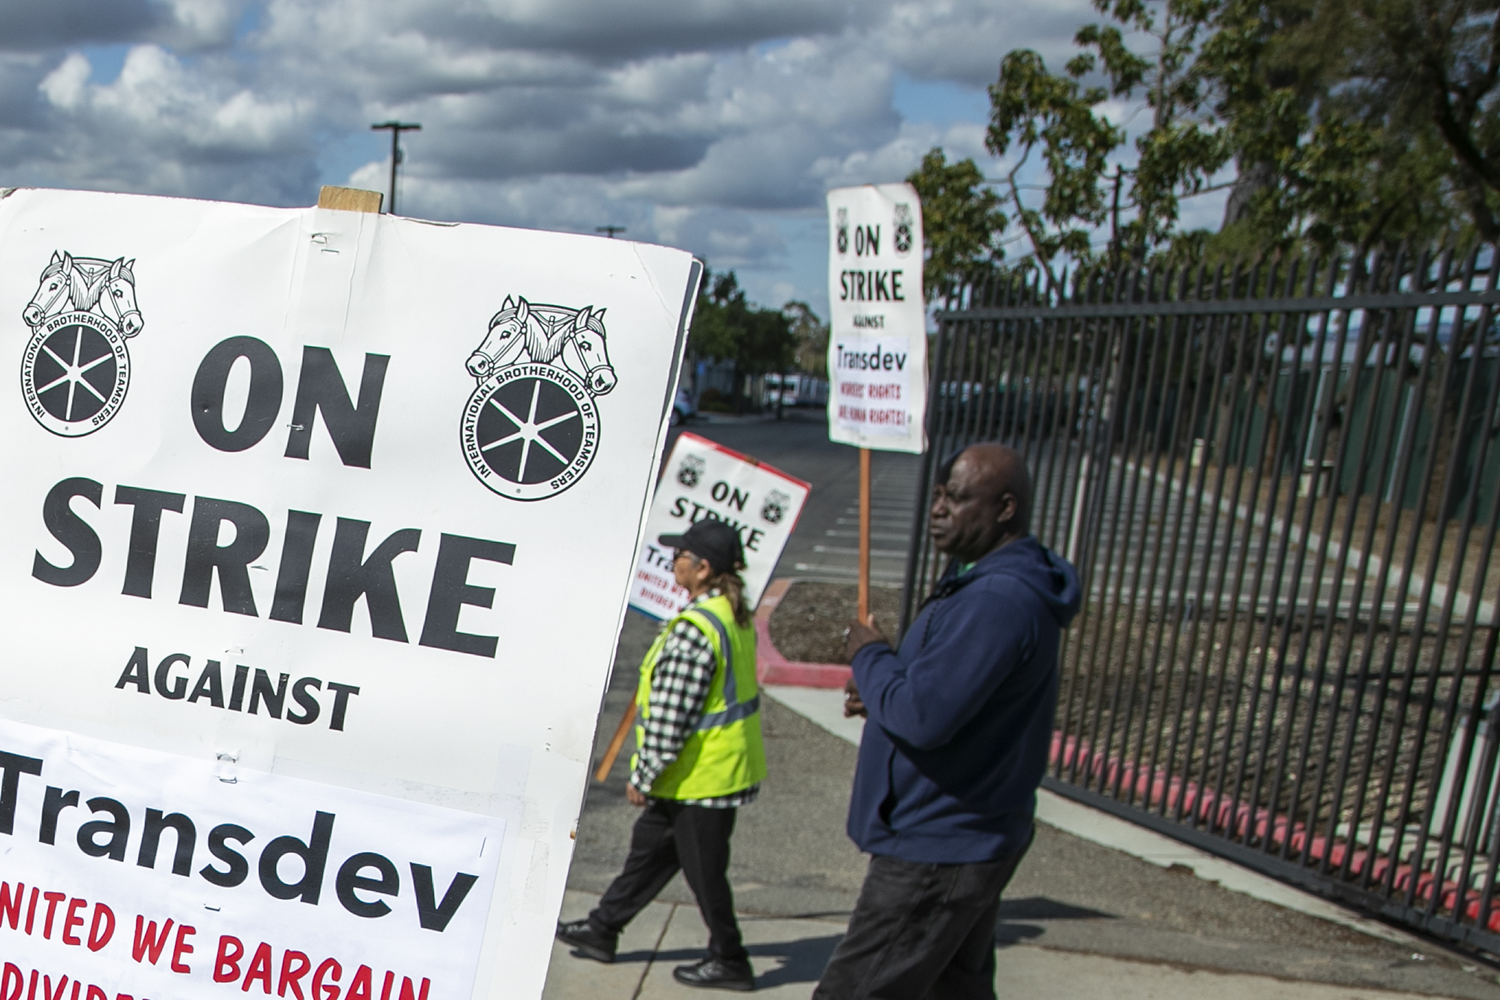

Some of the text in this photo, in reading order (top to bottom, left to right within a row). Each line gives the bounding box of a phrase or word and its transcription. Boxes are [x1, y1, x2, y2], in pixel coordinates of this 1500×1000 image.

[855, 224, 880, 256] ON
[840, 270, 905, 301] STRIKE
[24, 314, 127, 426] INTERNATIONAL BROTHERHOOD OF TEAMSTERS
[837, 344, 907, 371] Transdev
[190, 335, 391, 469] ON
[465, 366, 595, 490] INTERNATIONAL BROTHERHOOD OF TEAMSTERS
[711, 480, 750, 512] ON
[31, 476, 516, 658] STRIKE
[115, 646, 360, 732] AGAINST
[132, 914, 197, 974] WE
